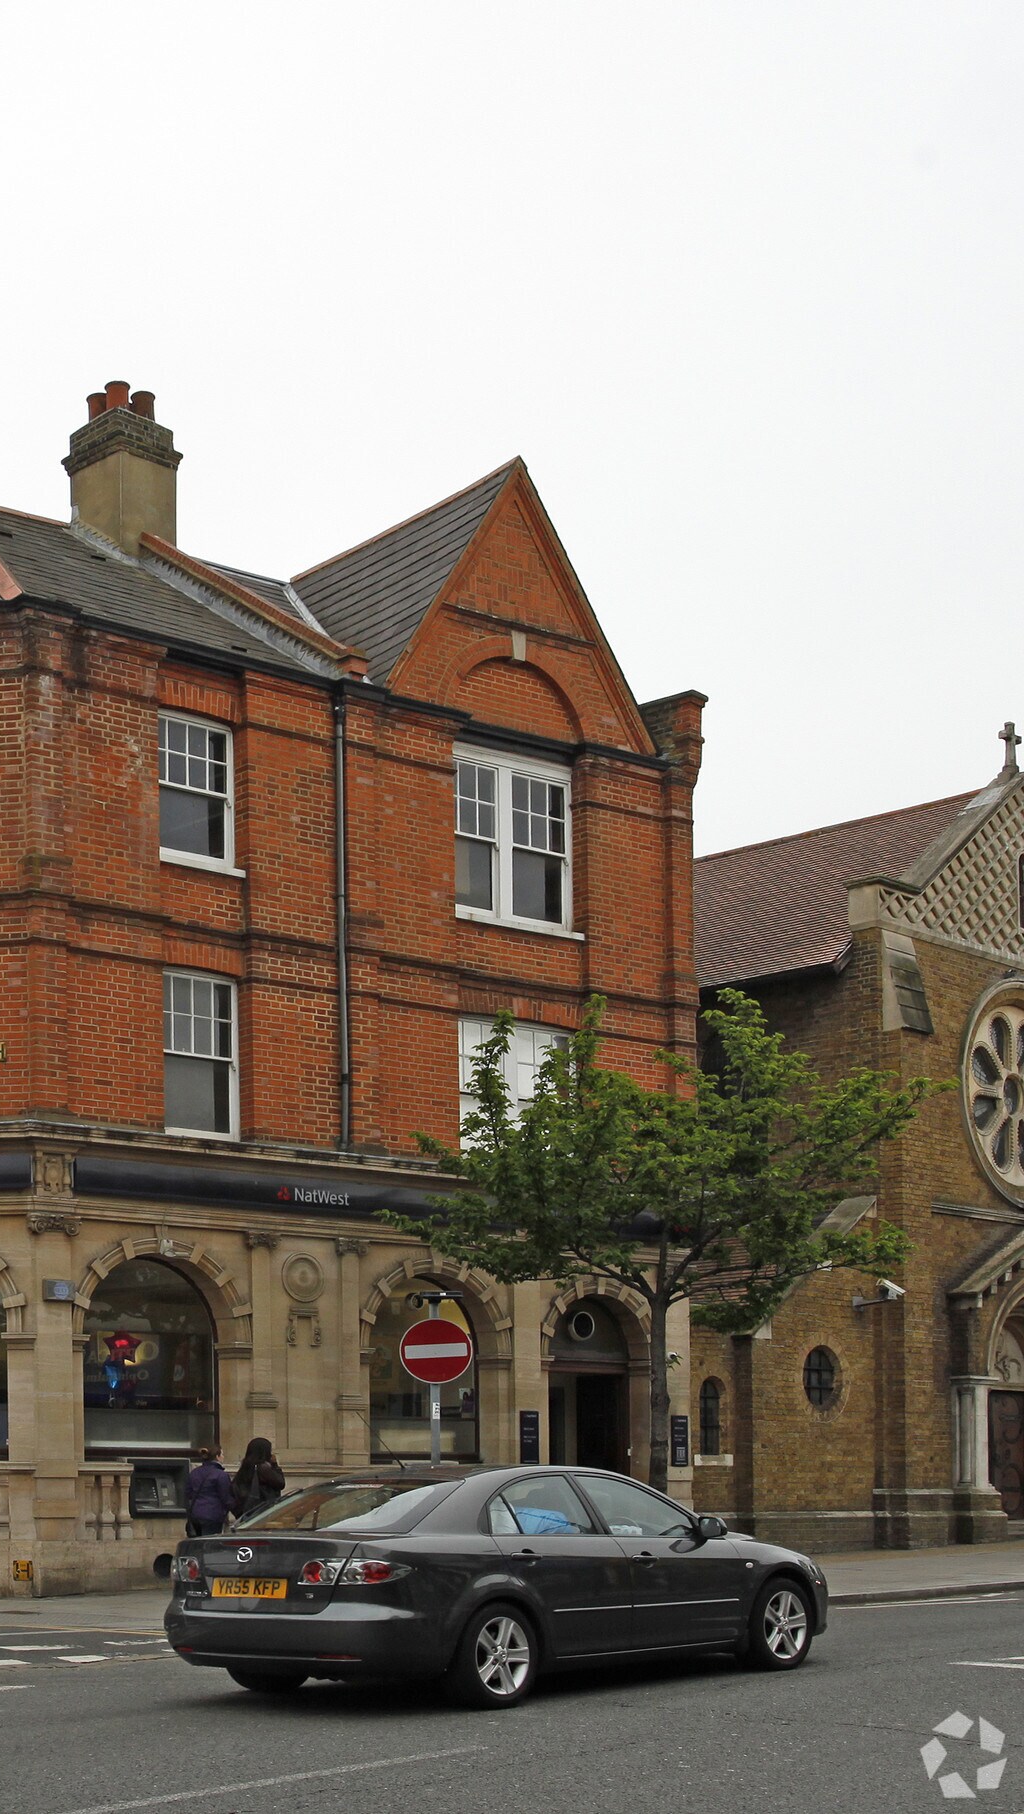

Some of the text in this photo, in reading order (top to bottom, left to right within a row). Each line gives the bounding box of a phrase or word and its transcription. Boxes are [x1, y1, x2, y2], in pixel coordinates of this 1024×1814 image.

[294, 1187, 350, 1206] NatWest
[218, 1579, 249, 1595] YR55
[253, 1580, 281, 1596] KFP
